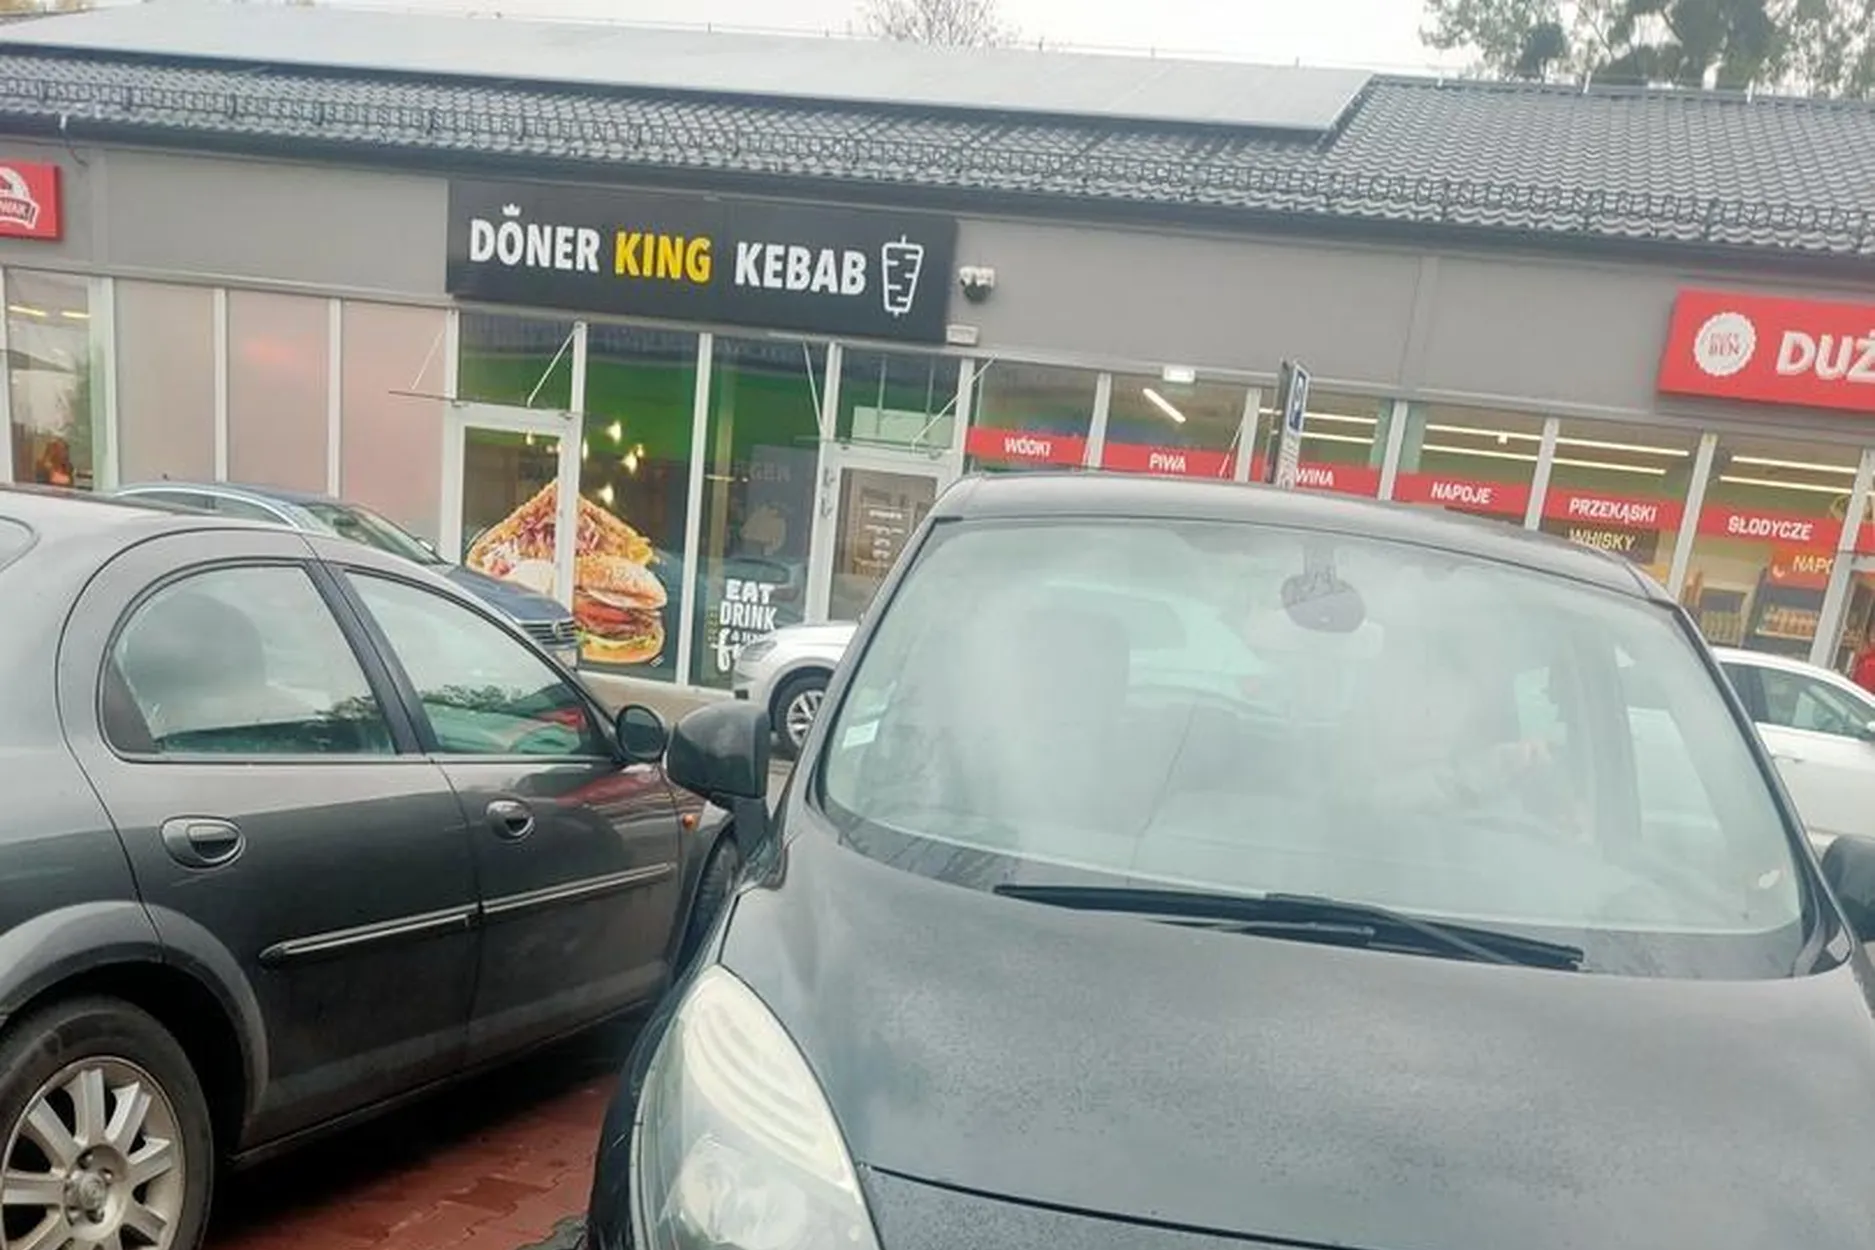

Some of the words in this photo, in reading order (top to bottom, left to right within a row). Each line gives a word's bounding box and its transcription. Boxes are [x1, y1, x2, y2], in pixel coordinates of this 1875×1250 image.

[614, 230, 712, 285] KING
[734, 241, 867, 296] KEBAB
[1149, 452, 1186, 473] PIWA
[1296, 467, 1334, 487] WINA
[1430, 482, 1492, 504] NAPOJE
[1569, 498, 1656, 524] PRZEKĄSKI
[1569, 528, 1635, 551] WHISKY
[1728, 516, 1813, 540] SŁODYCZE
[726, 578, 775, 605] EAT
[720, 600, 778, 631] DRINK
